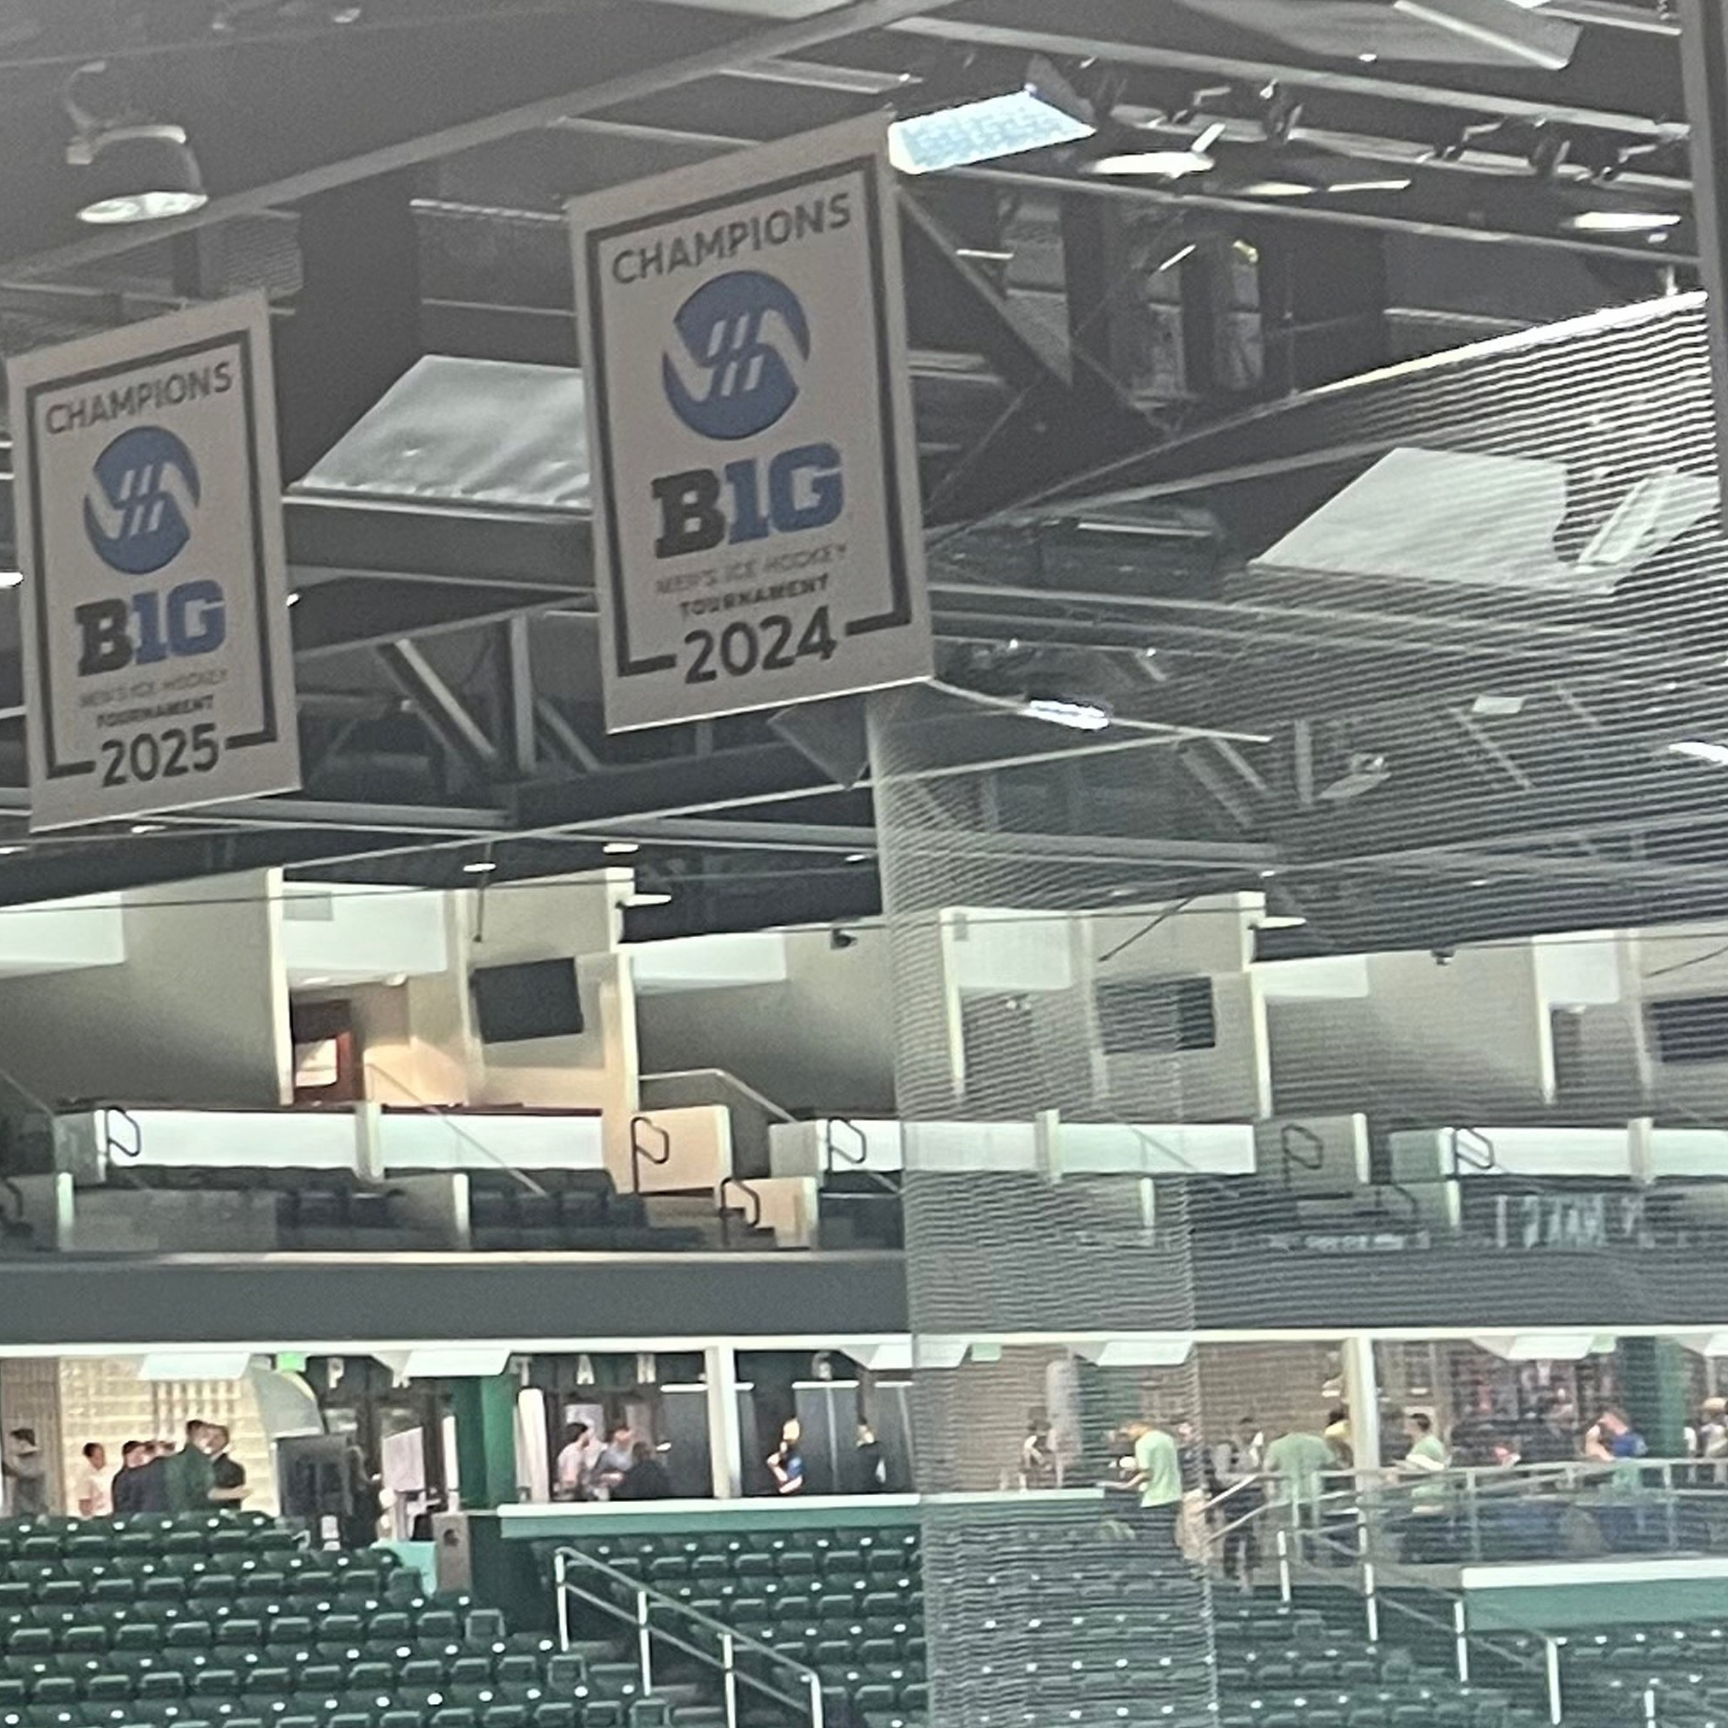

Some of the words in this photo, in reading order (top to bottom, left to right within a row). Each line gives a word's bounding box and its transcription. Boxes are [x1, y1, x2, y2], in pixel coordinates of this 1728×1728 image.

[612, 191, 852, 285] CHAMPIONS
[45, 361, 234, 435] CHAMPIONS
[724, 559, 757, 581] ICE
[762, 541, 848, 573] HOCKEY
[679, 572, 829, 618] TOURNAMENT
[684, 604, 838, 685] 2024
[96, 694, 215, 729] TOURNAMENT
[101, 722, 220, 788] 2025
